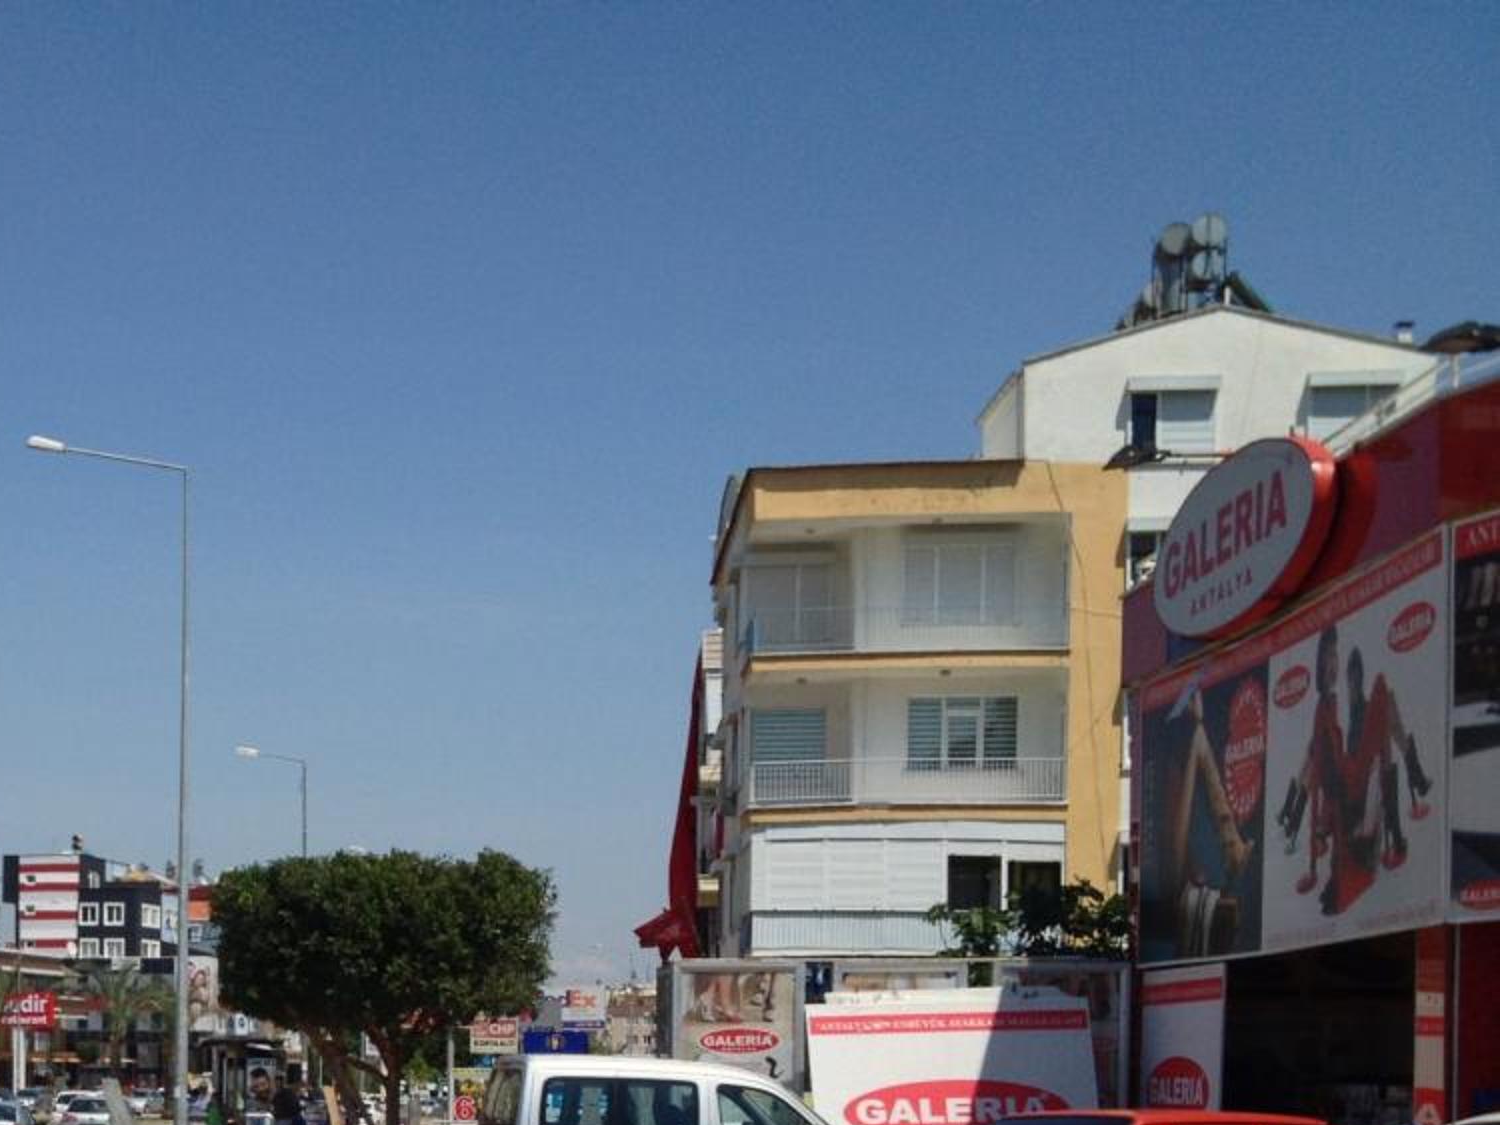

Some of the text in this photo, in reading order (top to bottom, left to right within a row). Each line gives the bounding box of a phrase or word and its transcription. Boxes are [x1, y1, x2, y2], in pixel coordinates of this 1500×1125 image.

[1164, 470, 1287, 598] GALERIA
[1190, 568, 1252, 616] ANTALYA
[703, 1035, 773, 1047] GALERIA
[855, 1097, 1044, 1125] GALERIA
